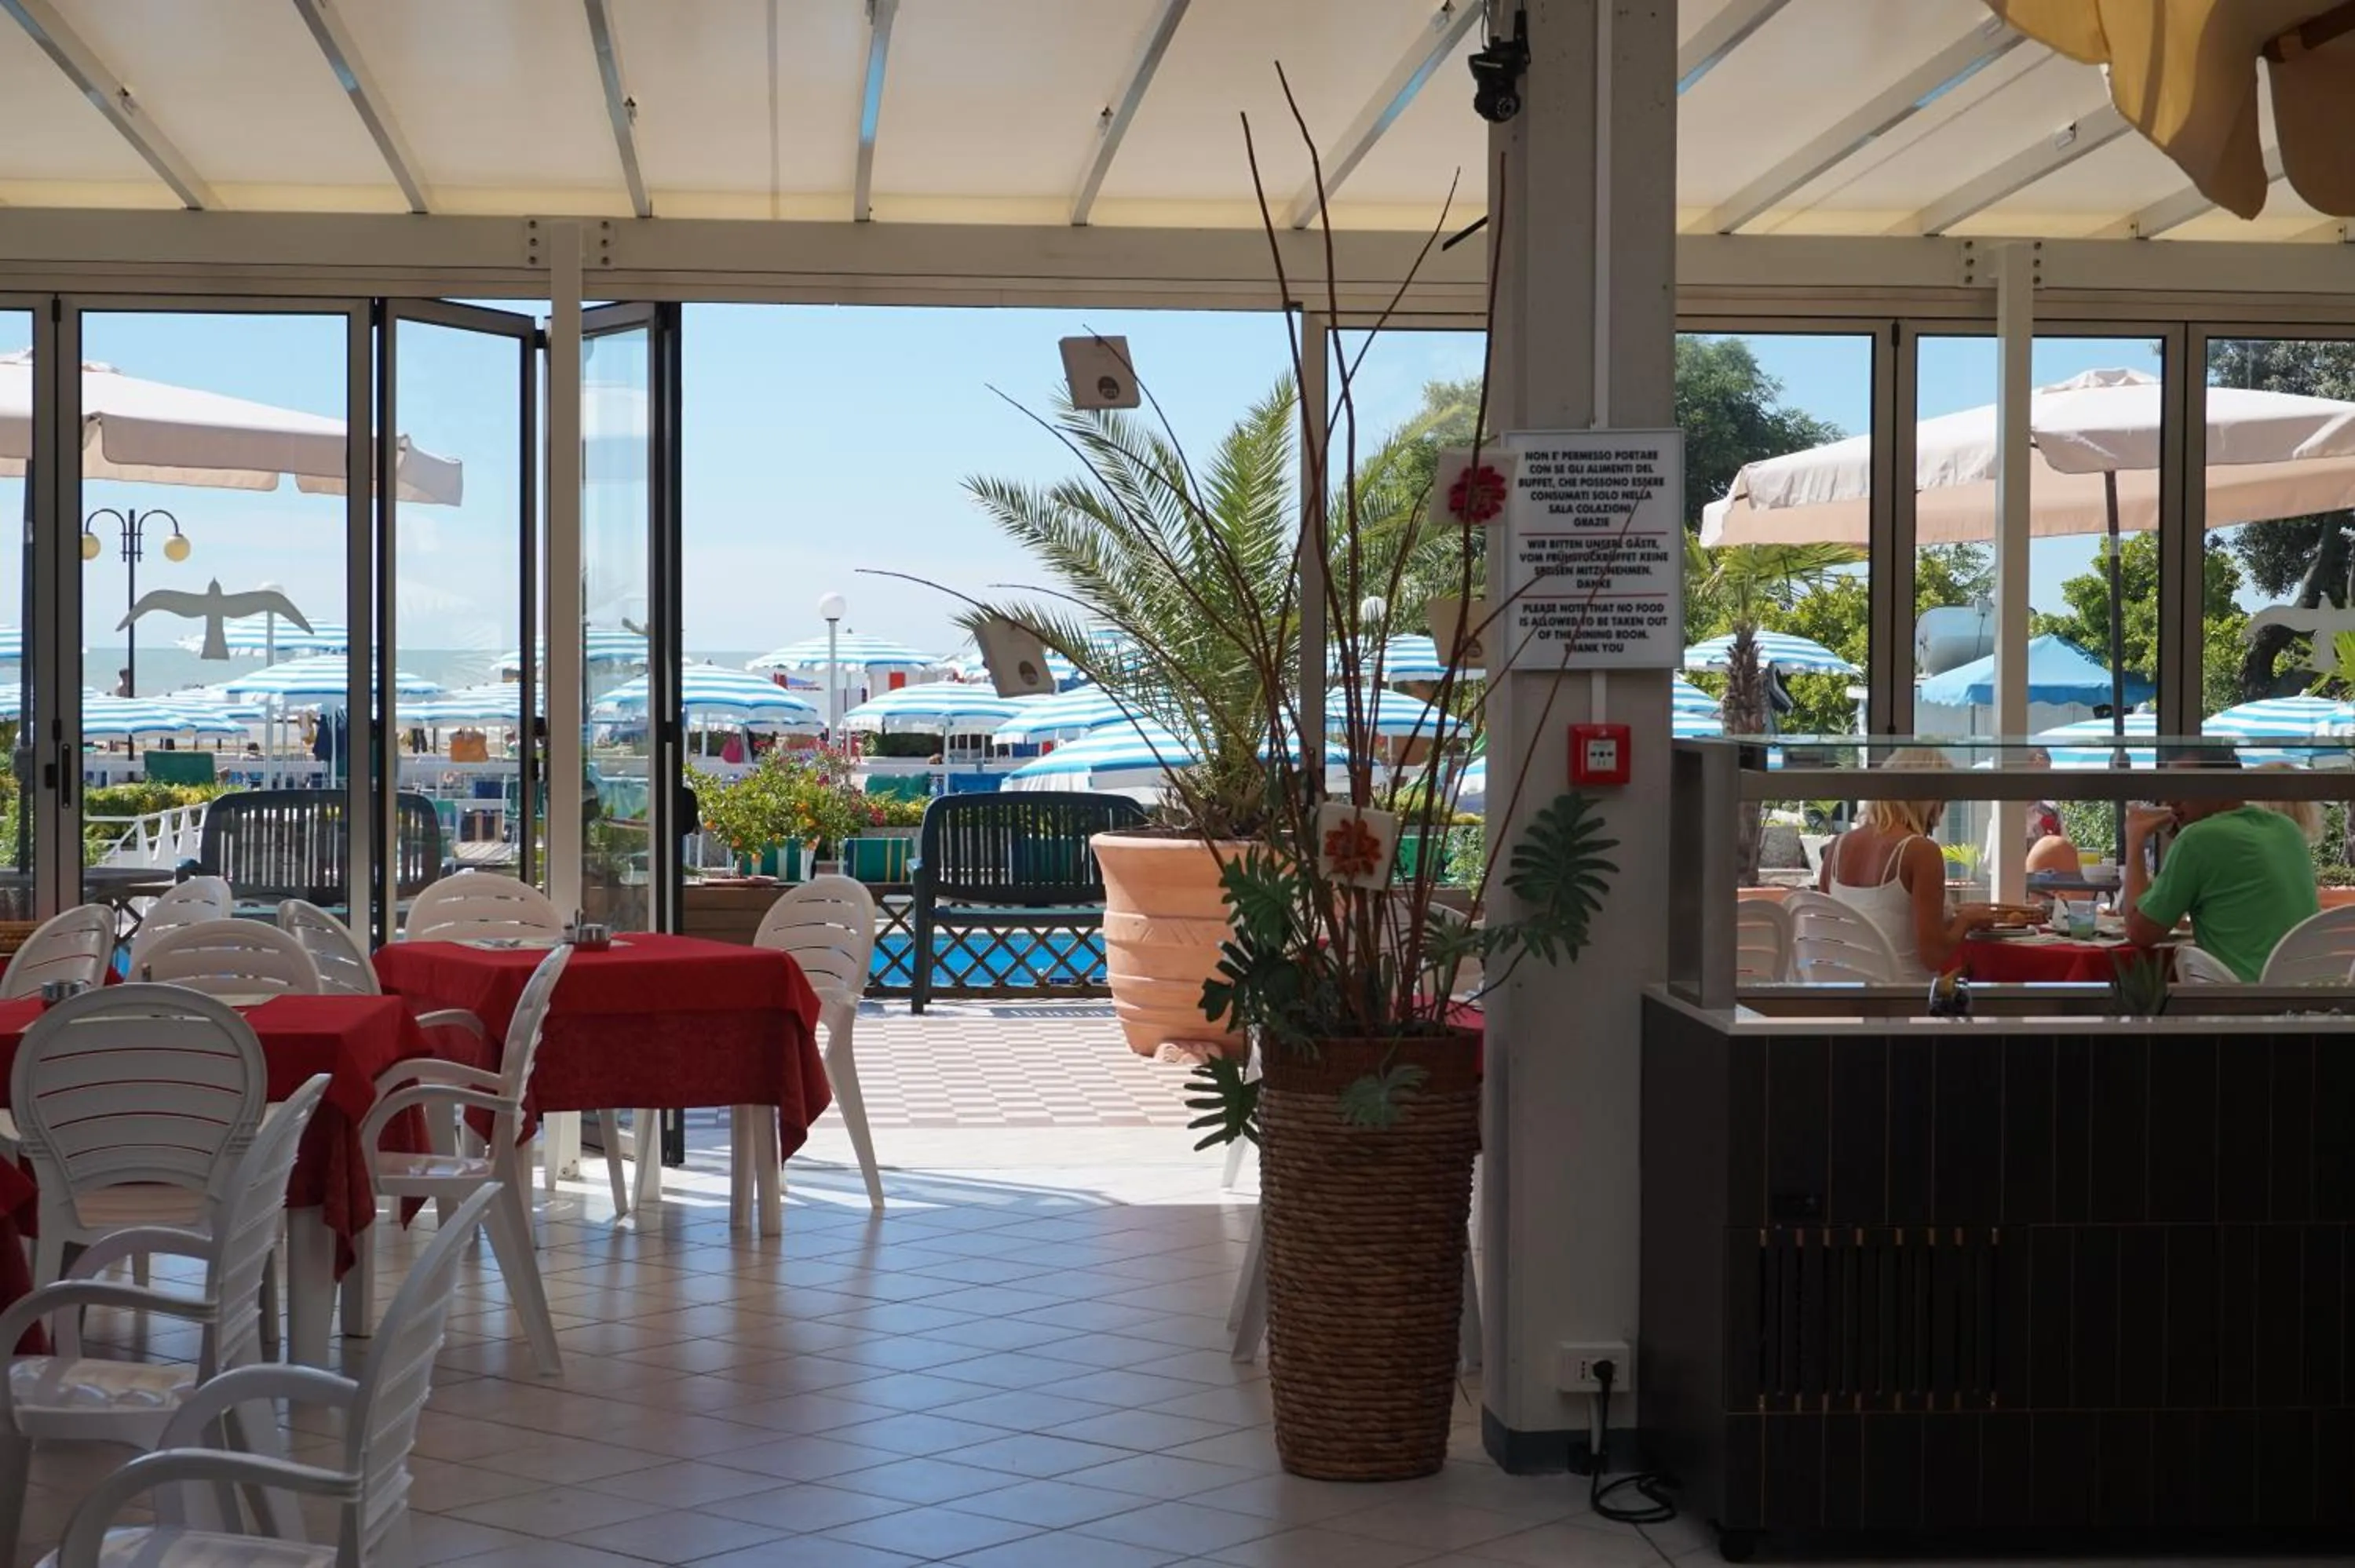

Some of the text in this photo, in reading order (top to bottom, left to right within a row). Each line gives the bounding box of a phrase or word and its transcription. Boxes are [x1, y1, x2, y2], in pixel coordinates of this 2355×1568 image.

[1524, 450, 1549, 461] NON
[1561, 450, 1612, 461] PERMESSO
[1615, 450, 1659, 461] PORTARE
[1529, 464, 1552, 475] CON
[1568, 464, 1584, 474] GLI
[1586, 463, 1633, 474] ALIMENTI
[1635, 463, 1654, 473] DEL
[1518, 476, 1665, 489] BUFFET, CHE POSSONO ESSERE
[1530, 490, 1652, 501] CONSUMATI SOLO NELLA
[1548, 503, 1631, 514] SALA COLAZIONI
[1573, 517, 1610, 527] GRAZIE
[1527, 539, 1546, 549] WIR
[1549, 538, 1583, 549] BITTEN
[1519, 552, 1544, 563] VOM
[1639, 551, 1669, 562] KEINE
[1576, 578, 1612, 589] DANKE
[1522, 603, 1665, 614] PLEASE NOTE THAT NO FOOD
[1519, 617, 1528, 627] IS
[1531, 616, 1578, 626] ALLOWED
[1597, 616, 1608, 626] BE
[1611, 616, 1645, 626] TAKEN
[1646, 616, 1668, 626] OUT
[1537, 629, 1649, 640] OF THE DINING ROOM.
[1602, 643, 1624, 653] YOU
